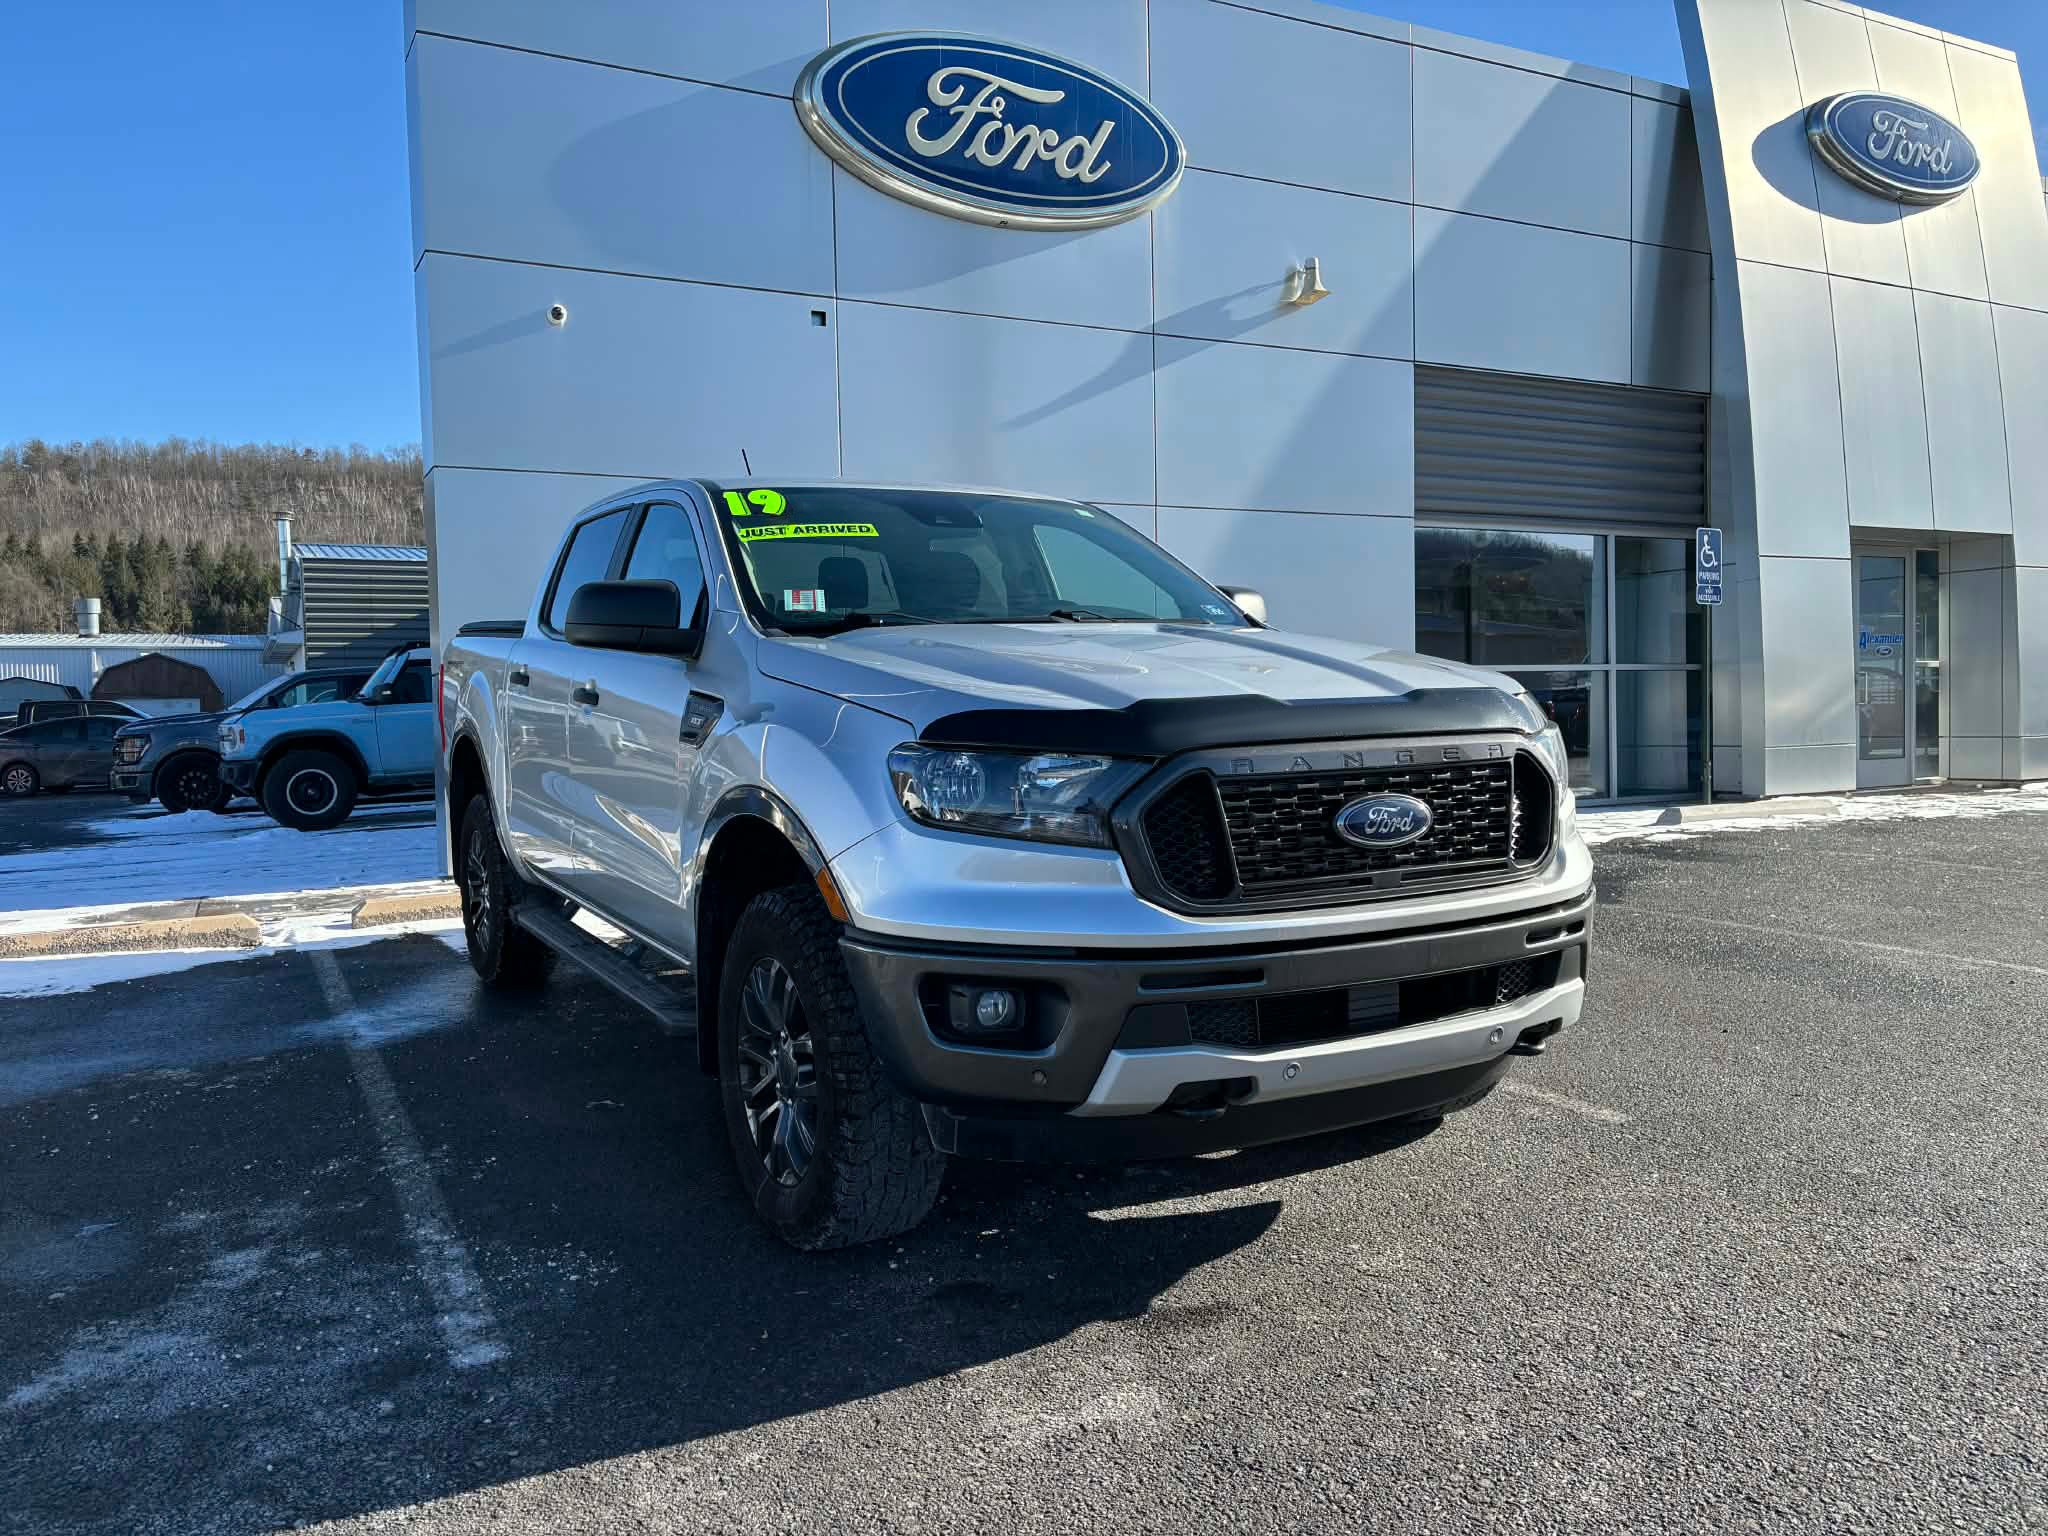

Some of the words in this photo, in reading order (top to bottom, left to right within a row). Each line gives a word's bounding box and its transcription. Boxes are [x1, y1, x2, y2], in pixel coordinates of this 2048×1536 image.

[905, 66, 1116, 184] Ford
[1867, 110, 1953, 175] Ford
[722, 489, 787, 516] 19
[740, 526, 786, 539] JUST
[793, 524, 874, 534] ARRIVED
[1231, 743, 1504, 774] RANGER
[1364, 806, 1415, 835] Ford
